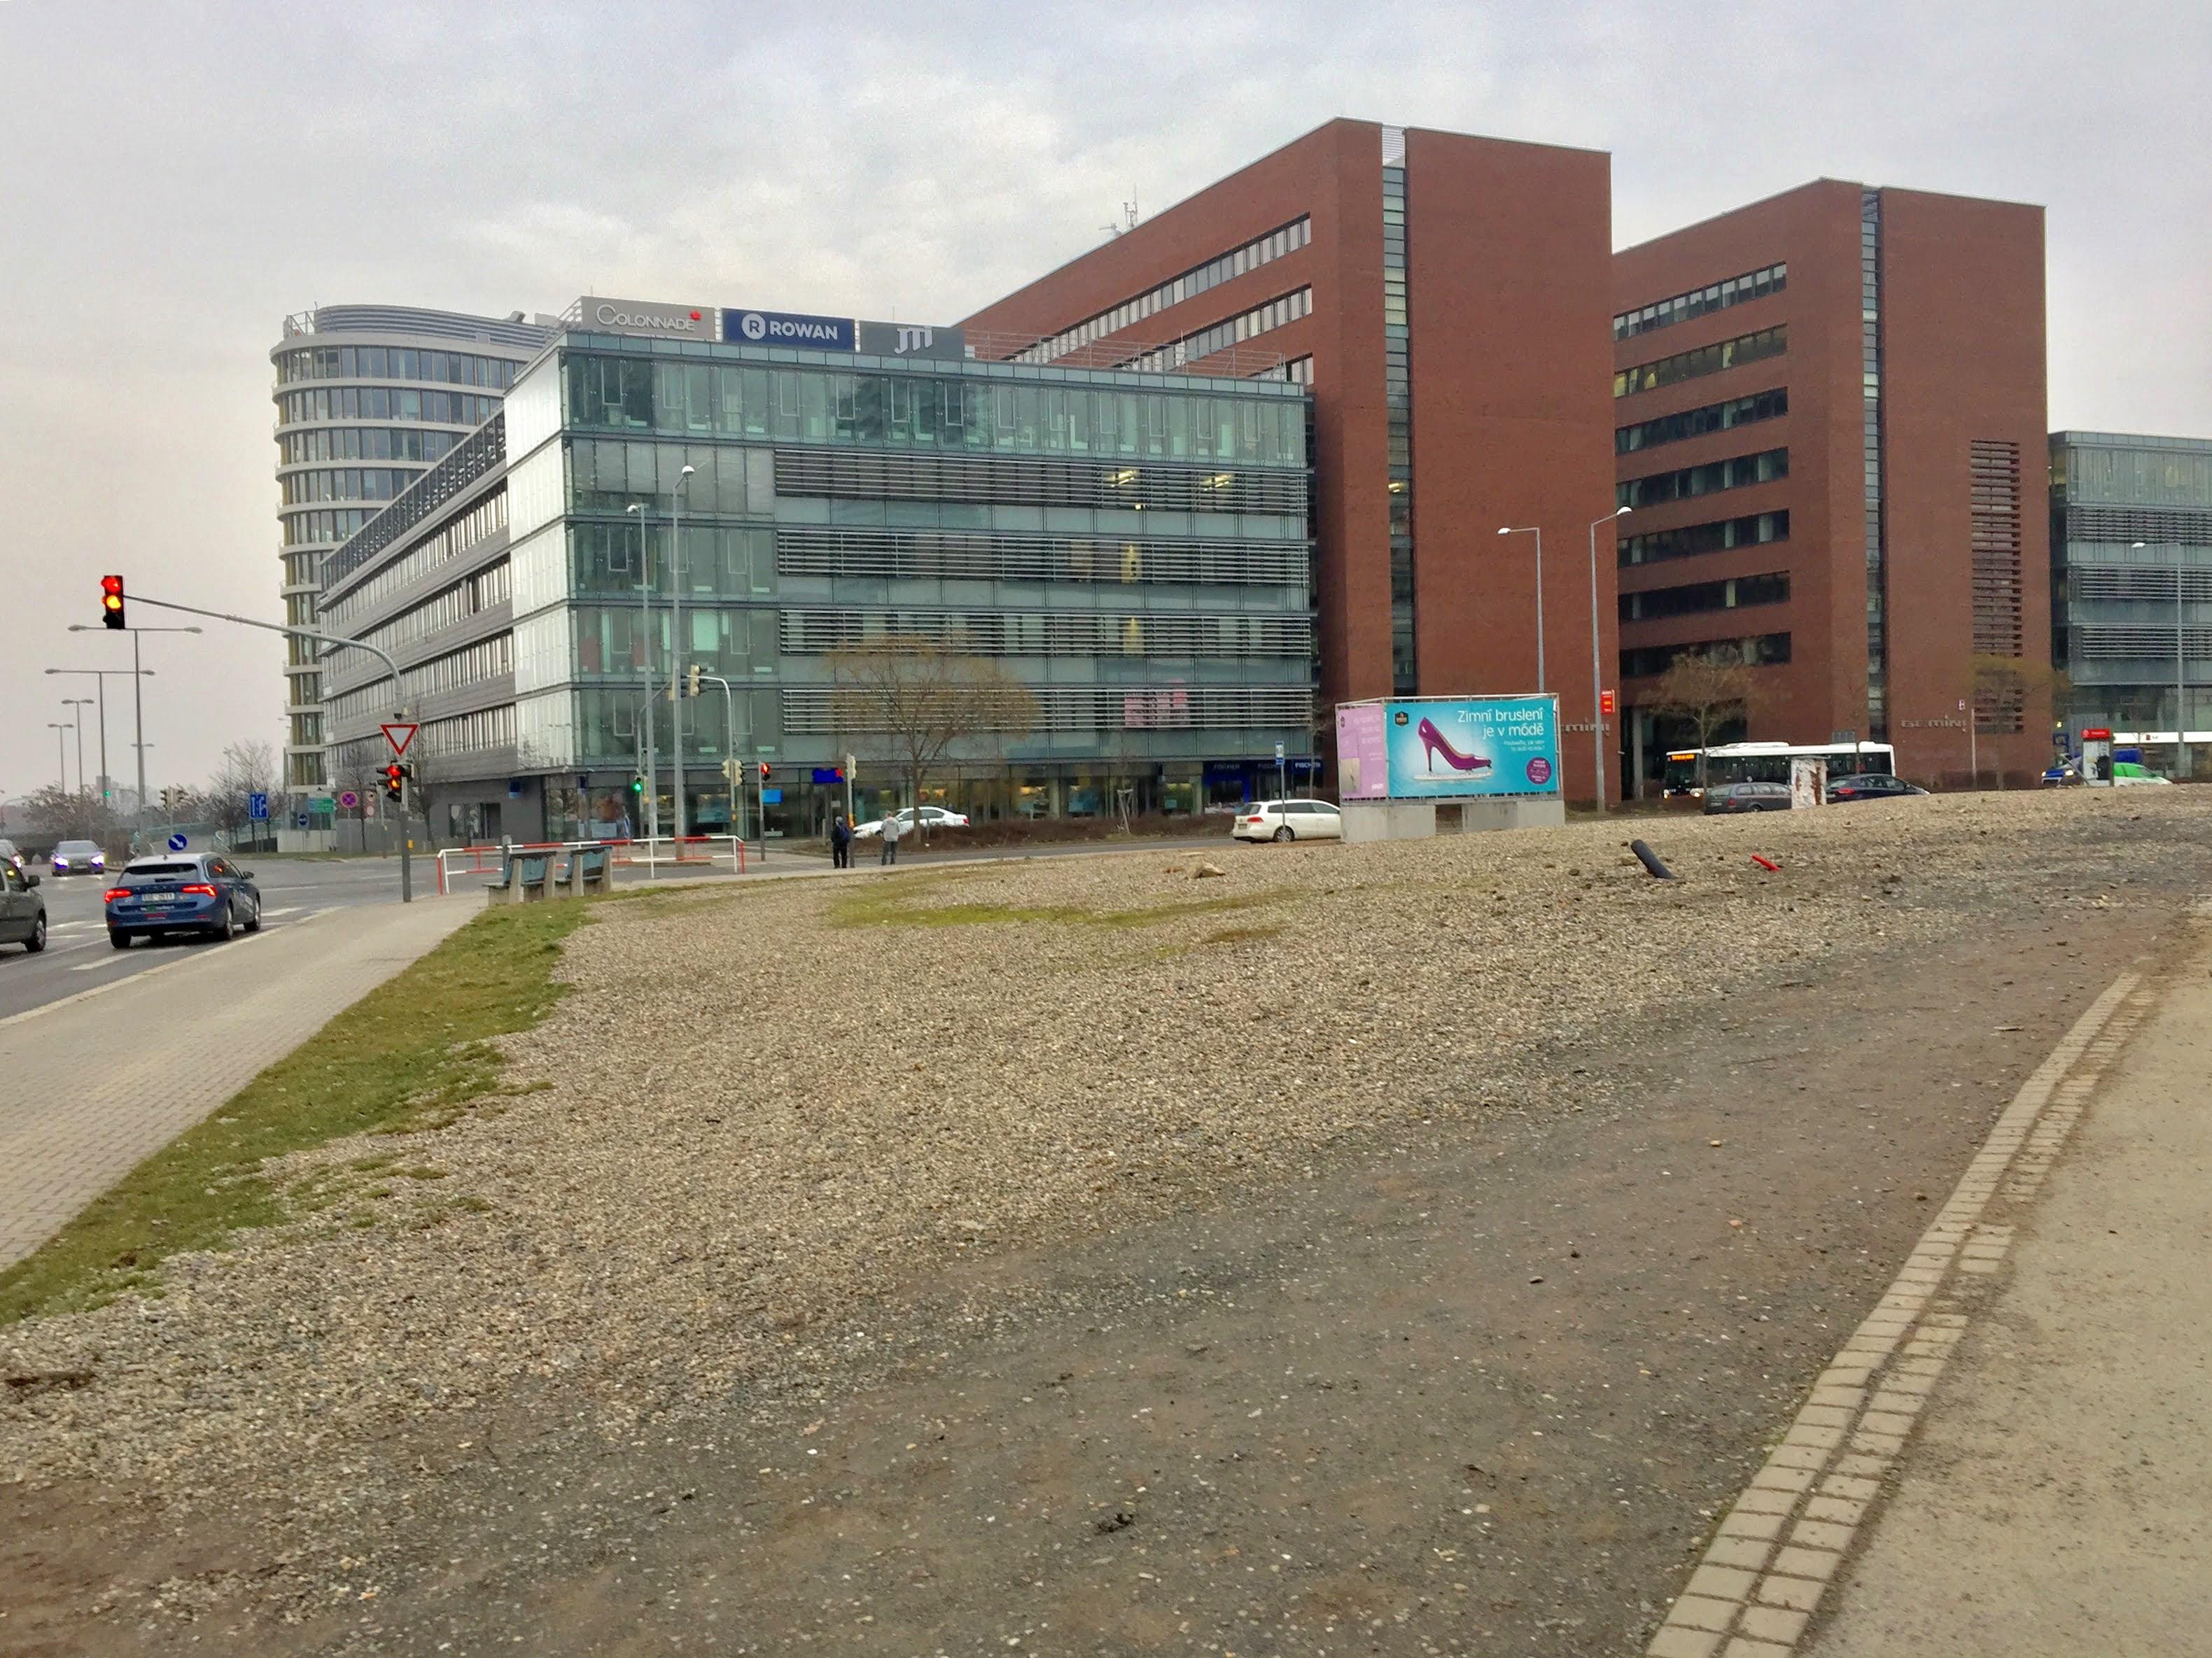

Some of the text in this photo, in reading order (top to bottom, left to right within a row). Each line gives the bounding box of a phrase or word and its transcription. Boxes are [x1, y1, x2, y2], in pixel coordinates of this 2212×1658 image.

[596, 304, 695, 331] COLONNADE
[770, 321, 838, 340] ROWAN
[894, 326, 933, 353] JTI
[1457, 707, 1544, 722] Zimní bruslení
[1483, 723, 1544, 739] je v módě
